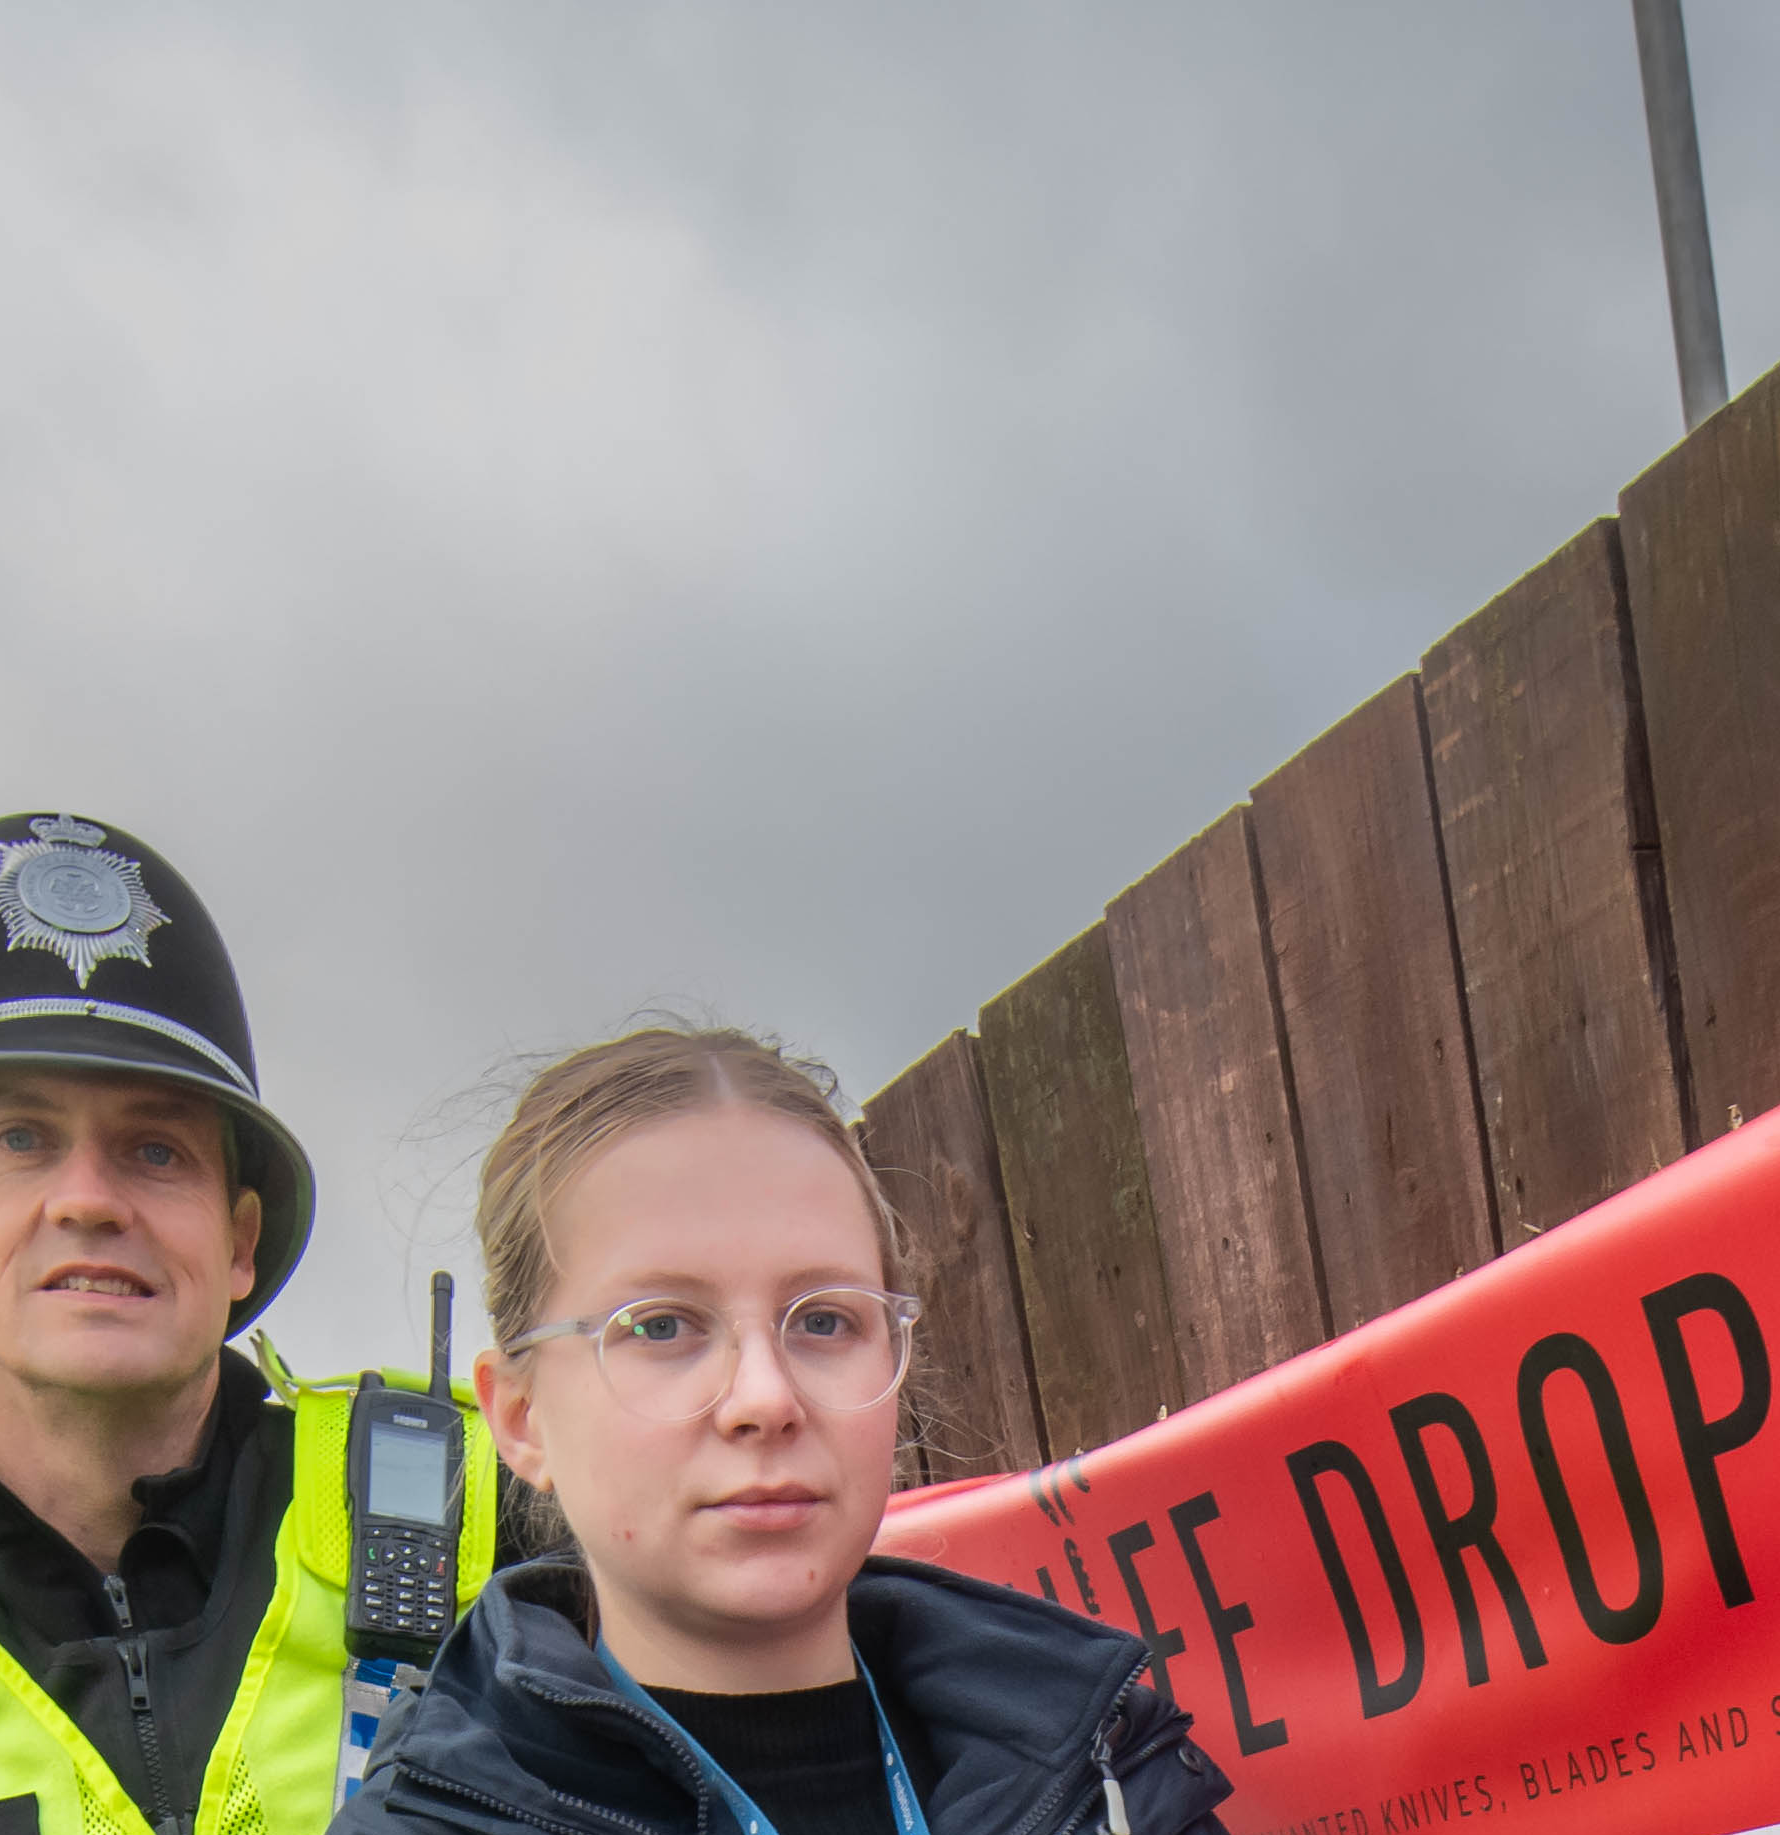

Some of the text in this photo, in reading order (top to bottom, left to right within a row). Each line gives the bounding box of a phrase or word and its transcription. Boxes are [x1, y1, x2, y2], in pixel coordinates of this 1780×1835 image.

[1285, 1271, 1773, 1718] DROP
[1381, 1775, 1508, 1835] KNIVES,
[1521, 1732, 1656, 1801] BLADES
[1677, 1704, 1751, 1765] AND
